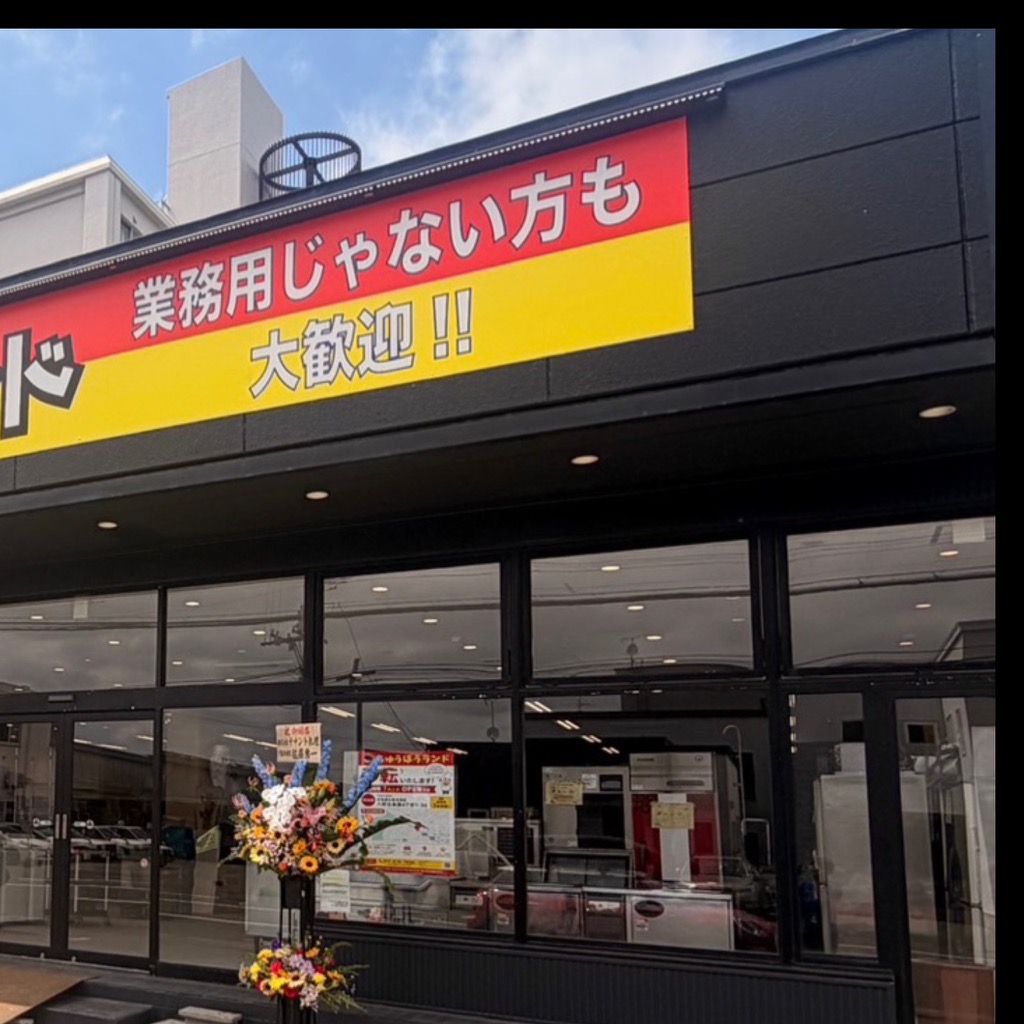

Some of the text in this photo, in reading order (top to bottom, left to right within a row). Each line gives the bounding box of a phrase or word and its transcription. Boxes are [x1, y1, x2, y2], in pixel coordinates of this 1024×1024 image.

[131, 154, 643, 341] 業務用じゃない方も
[384, 754, 451, 764] ゅうぼうランド
